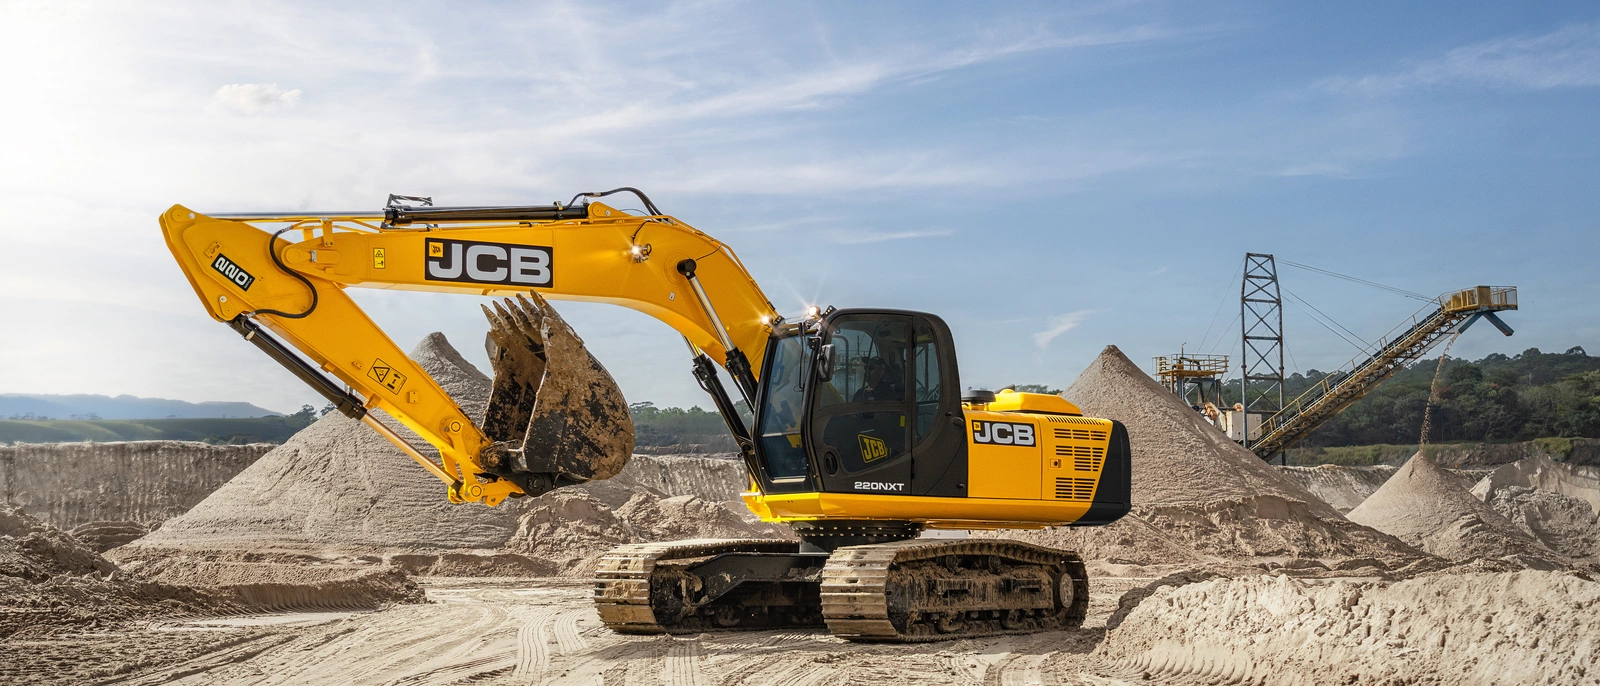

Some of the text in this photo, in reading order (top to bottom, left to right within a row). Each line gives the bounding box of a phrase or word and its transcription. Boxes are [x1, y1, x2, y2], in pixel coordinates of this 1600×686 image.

[214, 256, 249, 286] 220
[428, 243, 551, 284] JCB
[974, 422, 1035, 446] JCB
[863, 437, 885, 460] JCB
[854, 481, 905, 491] 220NXT
